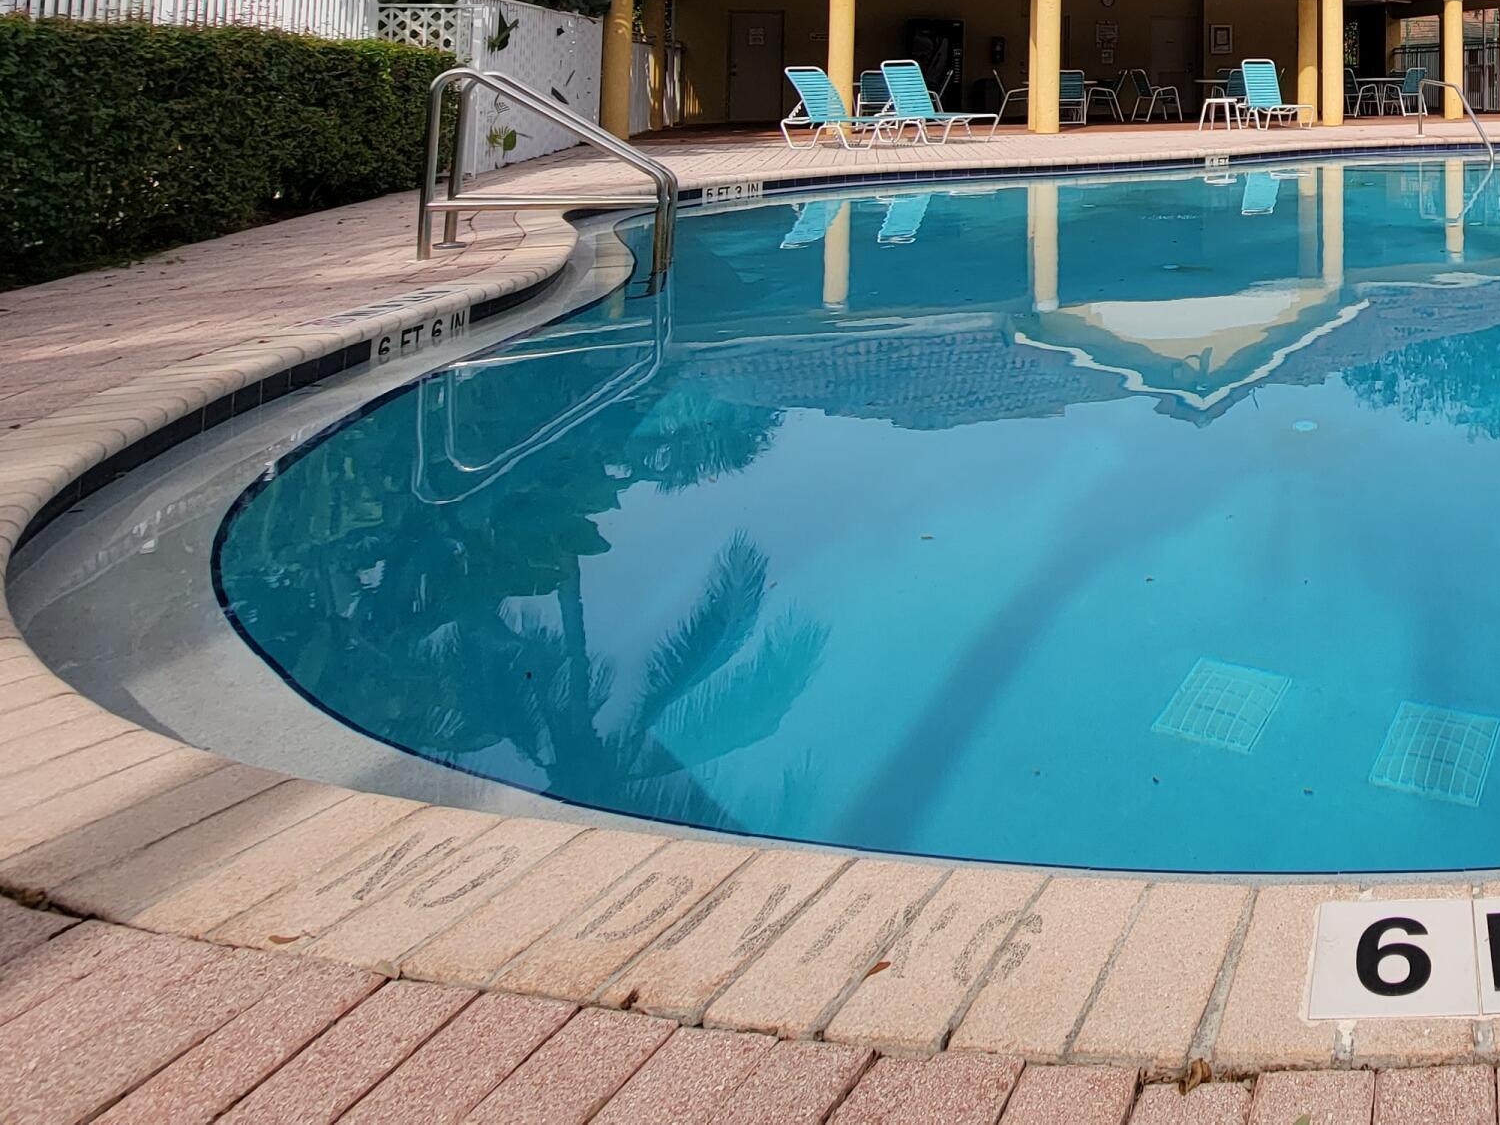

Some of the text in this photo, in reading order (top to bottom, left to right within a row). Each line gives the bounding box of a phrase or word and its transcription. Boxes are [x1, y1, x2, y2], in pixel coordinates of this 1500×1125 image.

[717, 186, 730, 197] FT
[747, 183, 759, 195] IN
[378, 310, 465, 356] 6 FT 6 IN
[314, 831, 1043, 987] NO DIVING
[1356, 916, 1432, 996] 6
